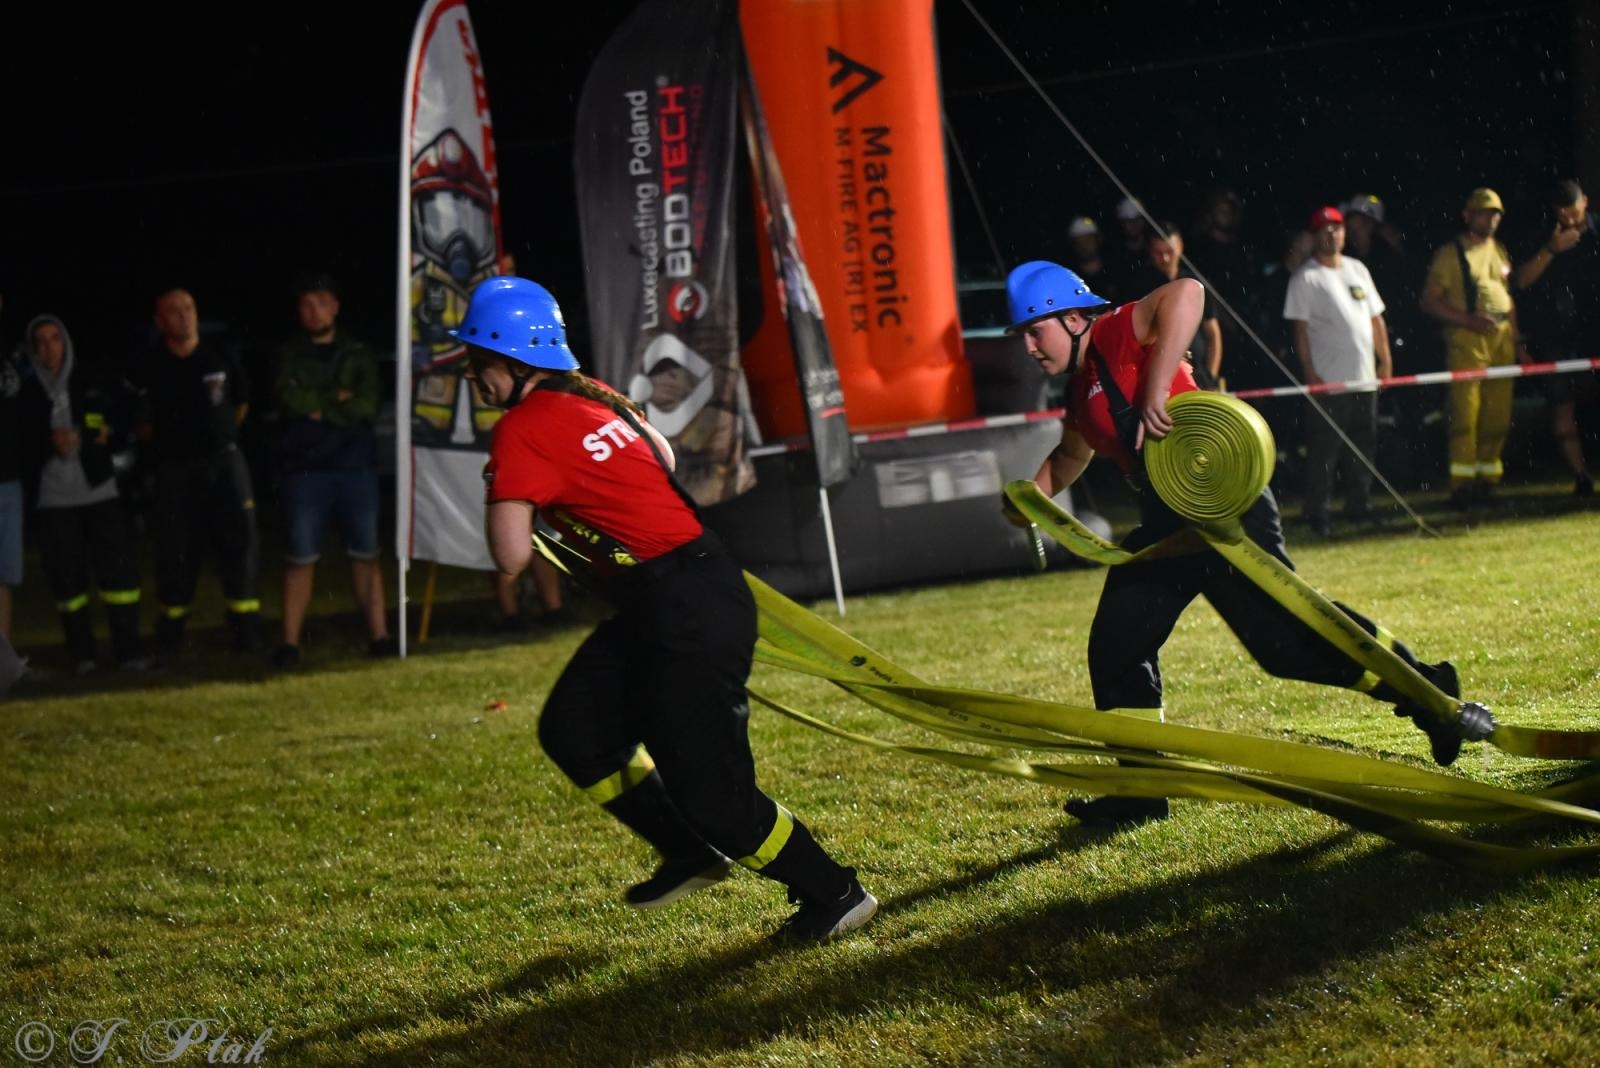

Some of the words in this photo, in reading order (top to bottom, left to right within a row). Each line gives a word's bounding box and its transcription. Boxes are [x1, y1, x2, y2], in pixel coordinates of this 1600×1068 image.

[624, 89, 652, 176] Poland
[632, 182, 660, 330] Luxecasting
[842, 220, 861, 253] AG
[861, 125, 909, 329] Mactronic
[849, 303, 870, 332] EX
